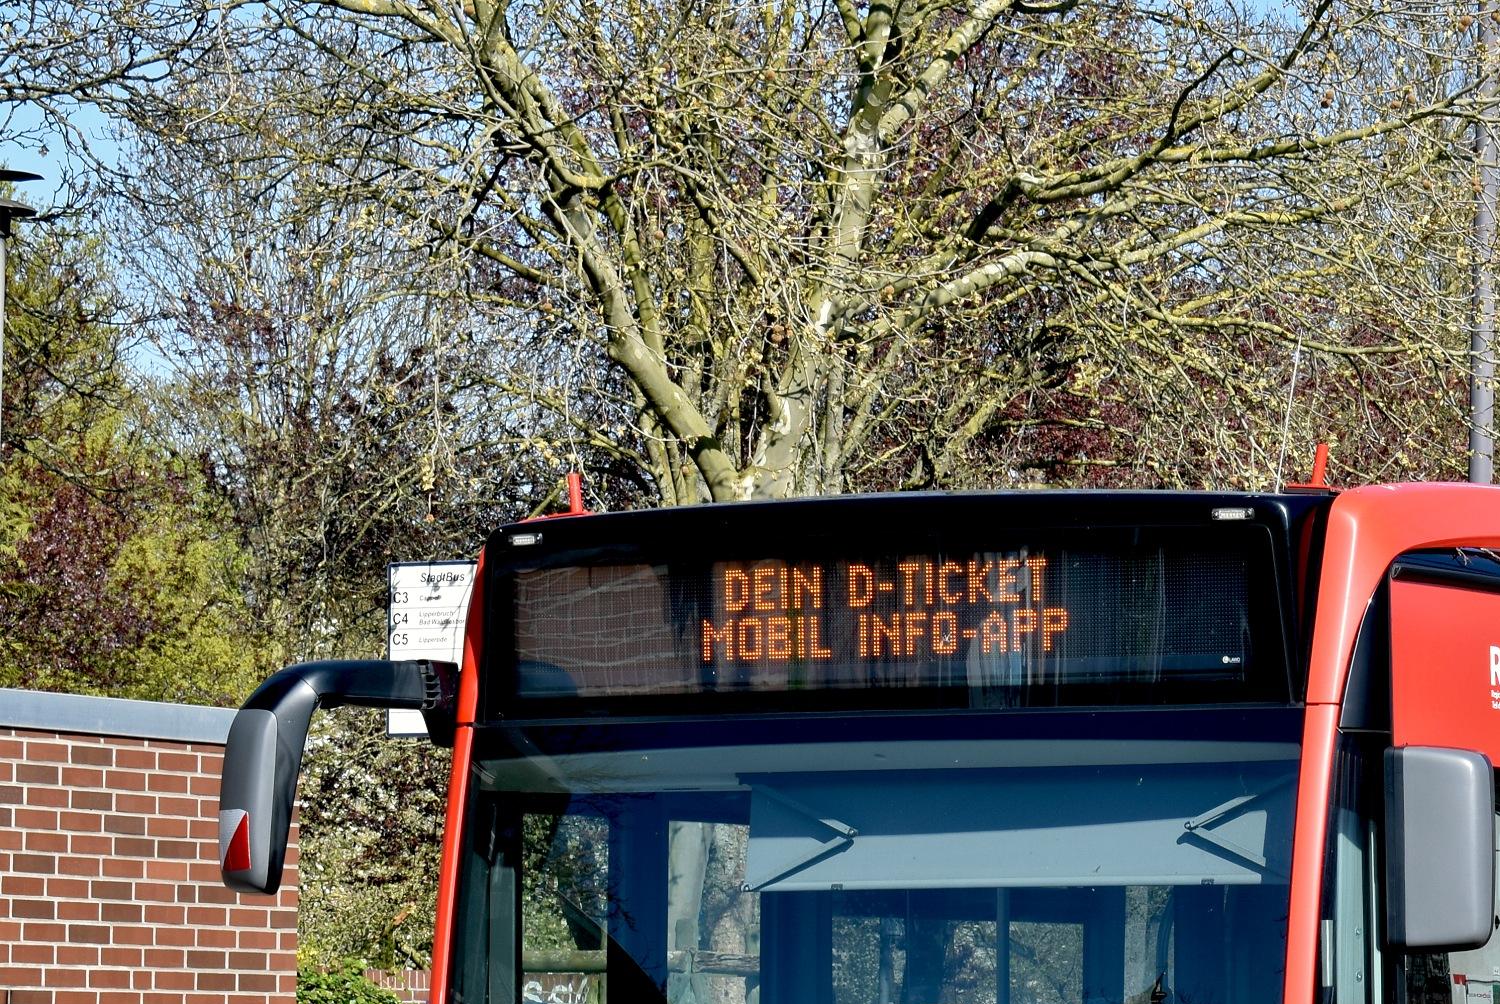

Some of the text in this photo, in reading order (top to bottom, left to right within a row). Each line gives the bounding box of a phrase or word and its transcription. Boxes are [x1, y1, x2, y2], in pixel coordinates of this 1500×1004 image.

[420, 572, 465, 583] StadtBus
[725, 558, 1047, 611] DEIN D-TICKET
[393, 591, 409, 604] C3
[393, 612, 409, 625] C4
[392, 633, 409, 646] C5
[703, 607, 1068, 661] MOBIL INFO-APP
